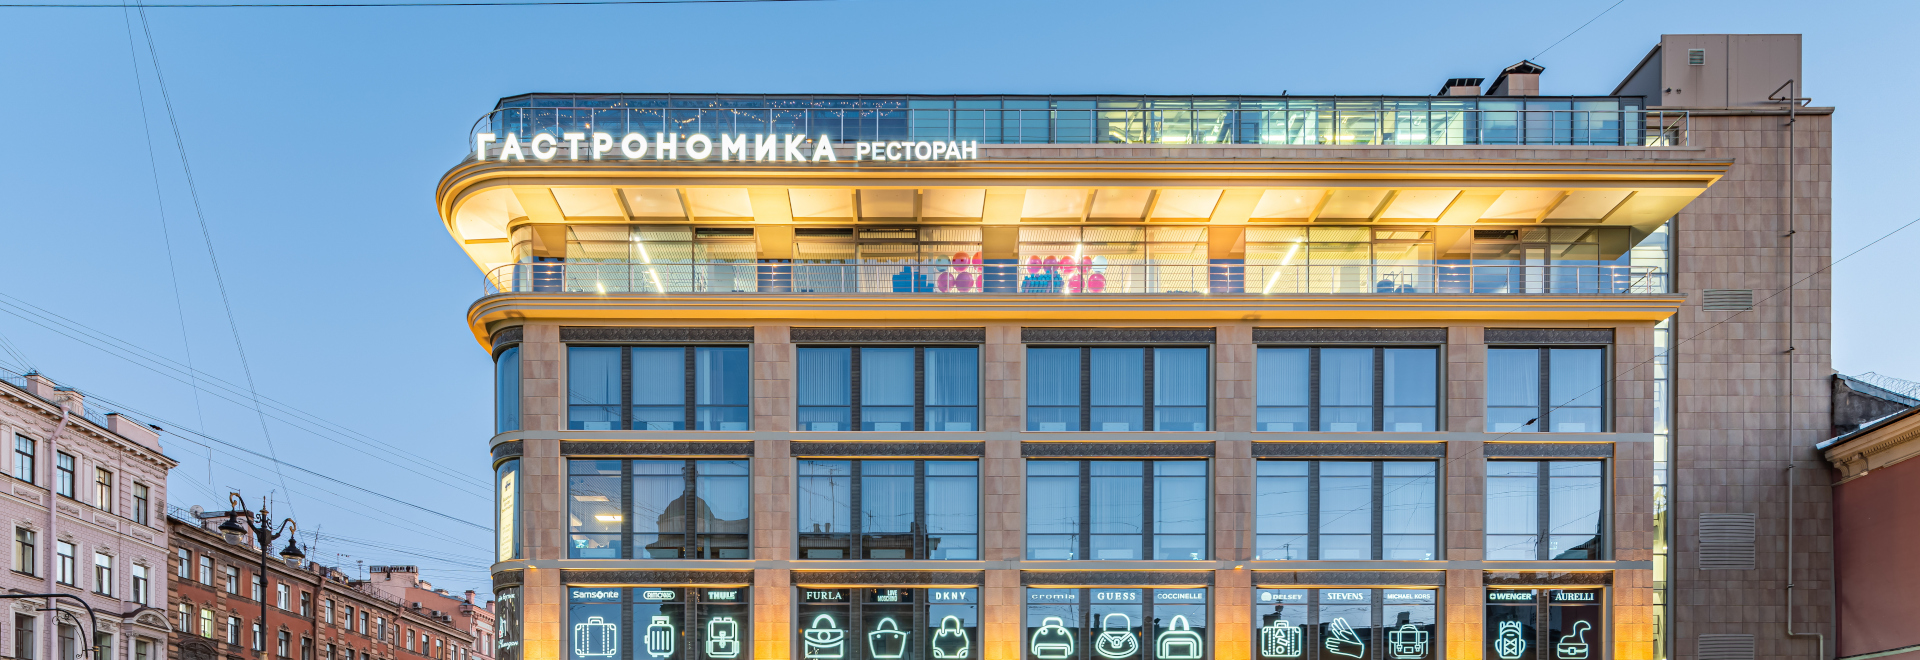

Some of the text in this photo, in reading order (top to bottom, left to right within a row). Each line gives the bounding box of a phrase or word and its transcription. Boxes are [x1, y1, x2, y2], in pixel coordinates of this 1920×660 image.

[476, 133, 978, 163] ГАСТРОНОМИКА РЕСТОРАН
[573, 591, 619, 599] Samsonite
[708, 591, 735, 600] THULE
[806, 591, 842, 600] FURLA
[935, 592, 966, 600] DKNY
[1097, 592, 1136, 601] GUESS
[1327, 592, 1363, 601] STEVENS
[1555, 592, 1594, 601] AURELLI
